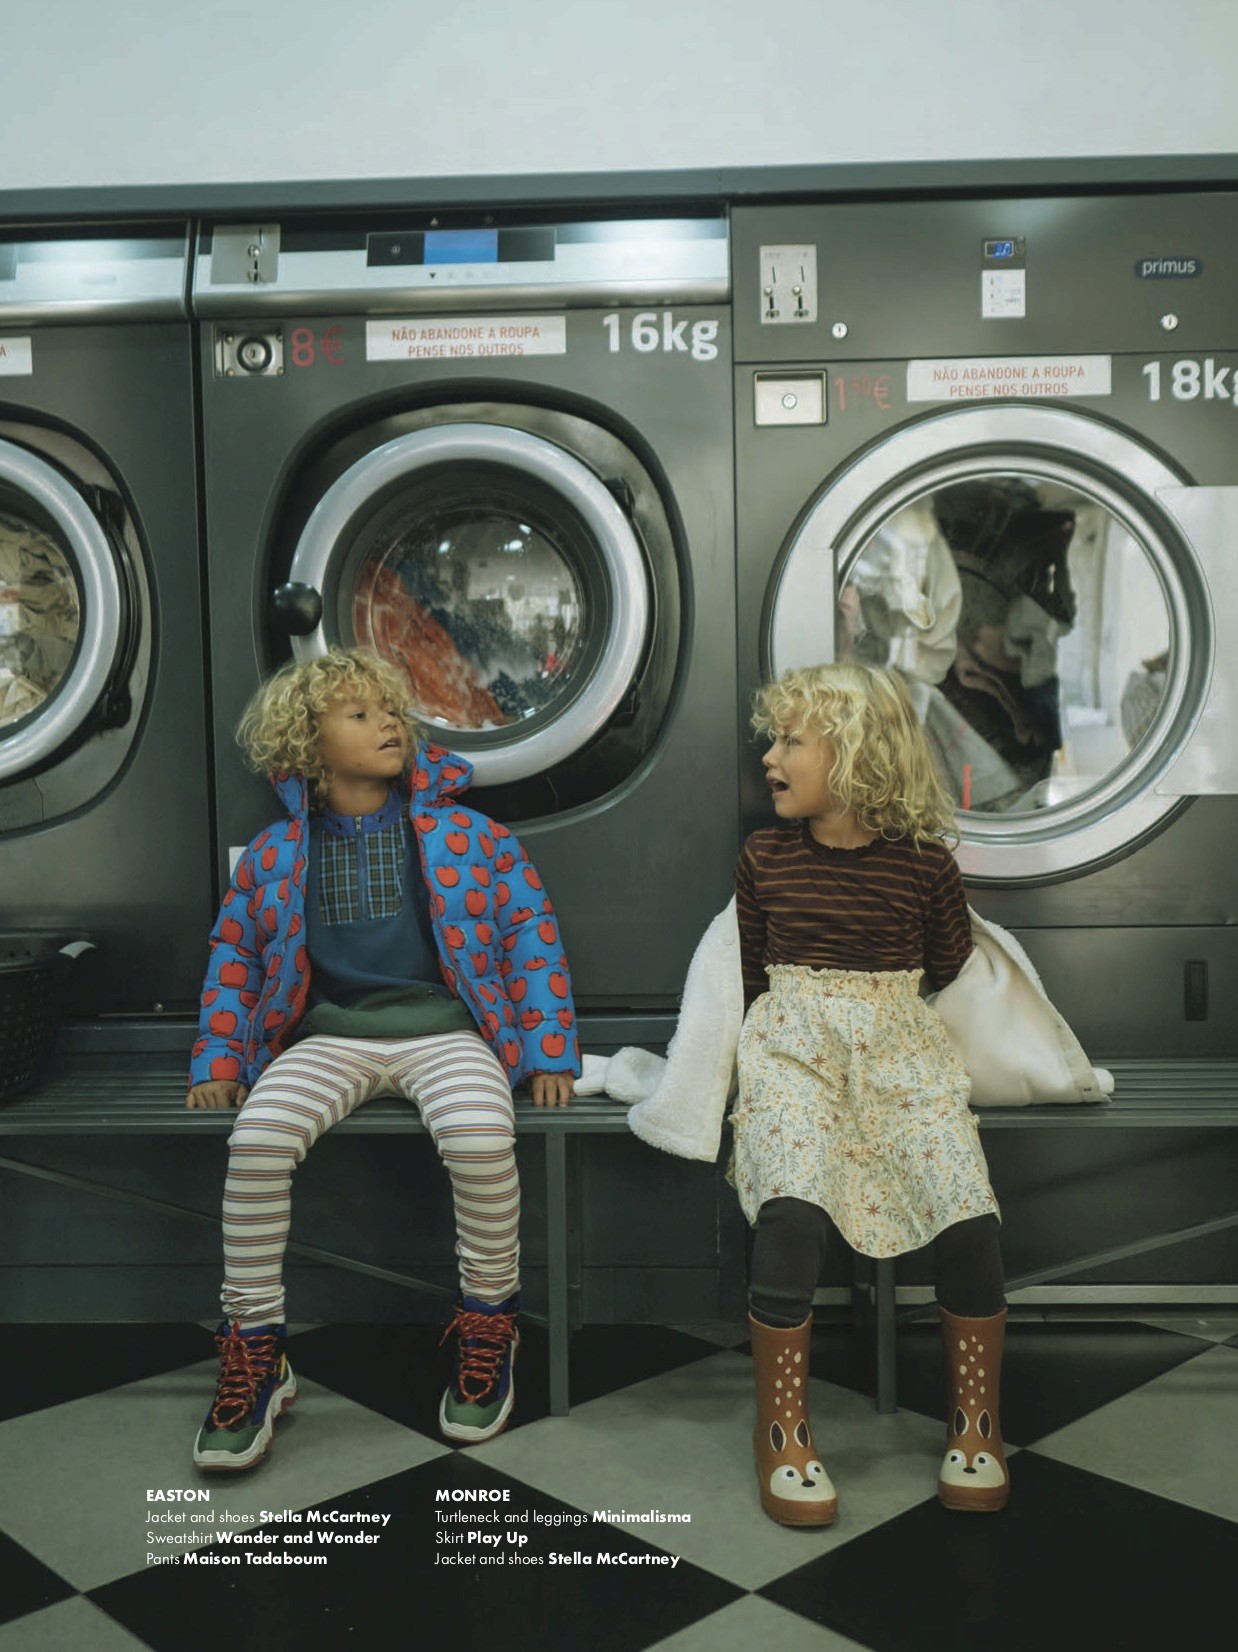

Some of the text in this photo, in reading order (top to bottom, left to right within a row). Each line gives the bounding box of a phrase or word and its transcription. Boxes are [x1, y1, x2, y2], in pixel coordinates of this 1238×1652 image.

[1142, 258, 1197, 278] primus
[391, 325, 541, 342] NÃO ABANDONE A ROUPA
[602, 311, 719, 361] 16kg
[408, 342, 525, 358] PENSE NOS OUTROS
[933, 364, 1085, 381] NÃO ABANDONE A ROUPA
[949, 382, 1069, 398] PENSE NOS OUTROS
[1142, 358, 1238, 408] 18k
